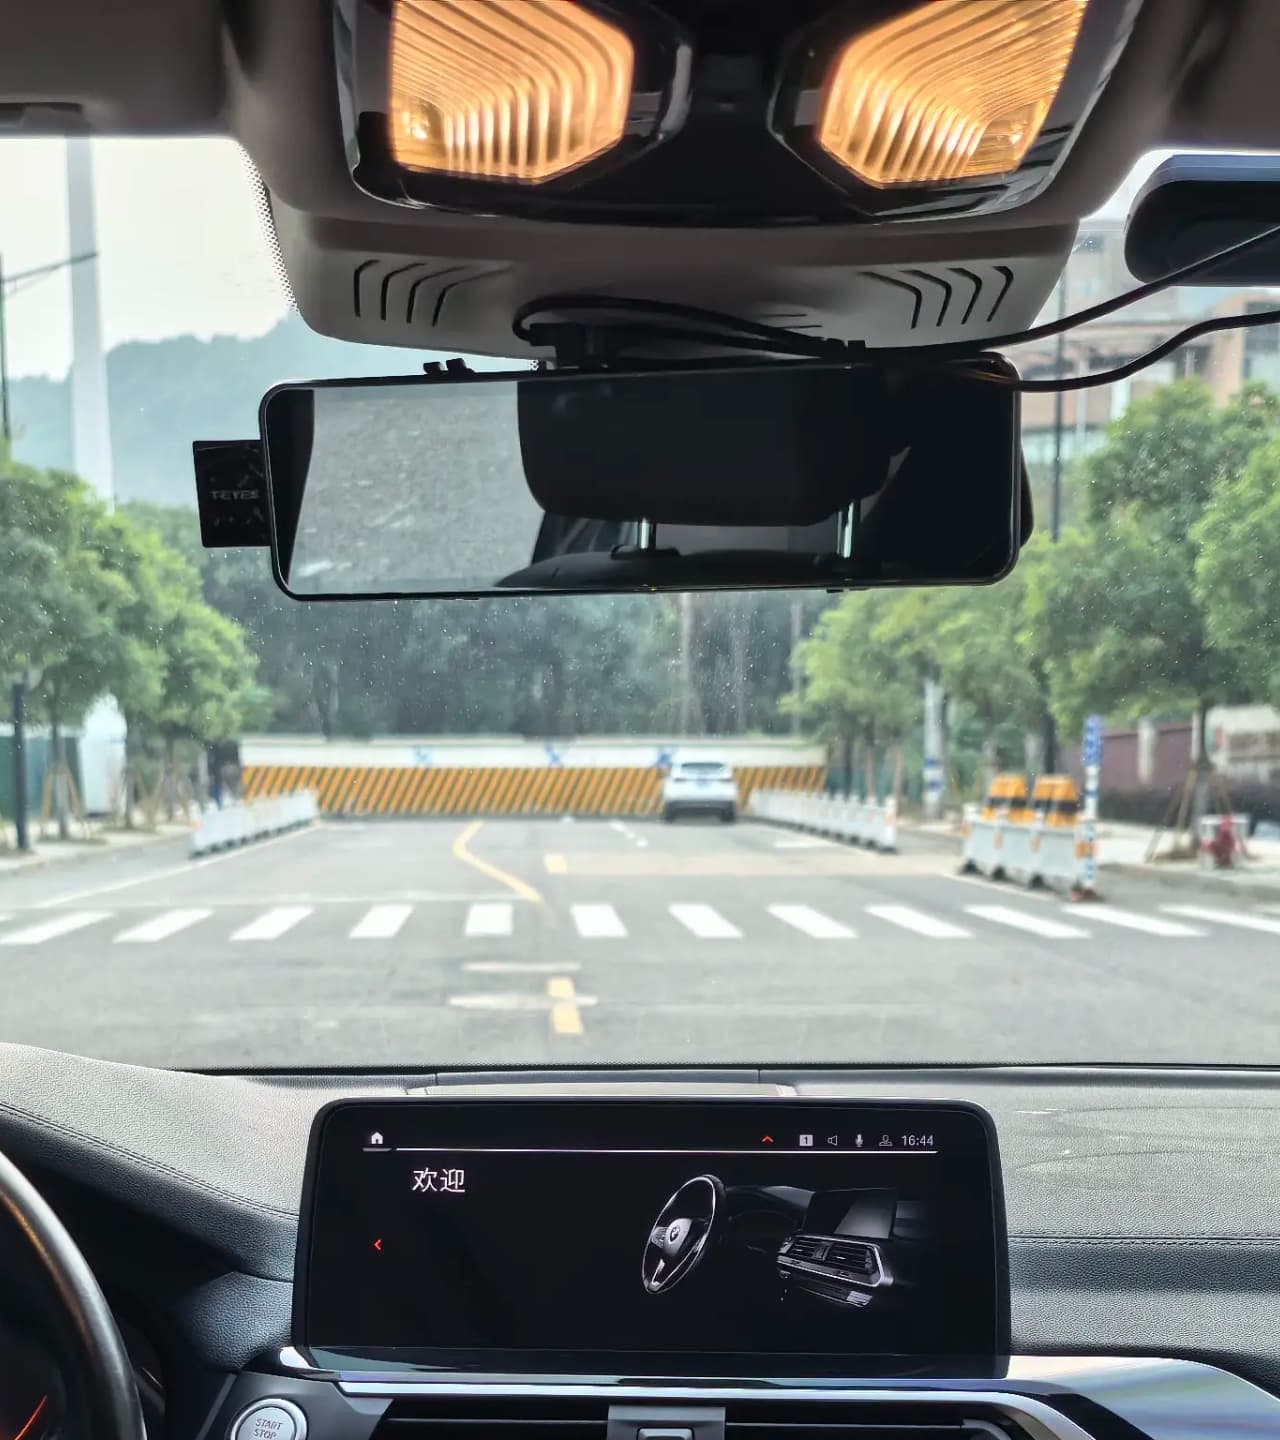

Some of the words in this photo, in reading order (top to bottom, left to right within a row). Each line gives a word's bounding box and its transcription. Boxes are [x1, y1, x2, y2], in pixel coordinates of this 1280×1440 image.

[901, 1135, 934, 1146] 16:44
[412, 1167, 466, 1192] 欢迎
[256, 1419, 284, 1431] START
[253, 1429, 277, 1440] STOP
